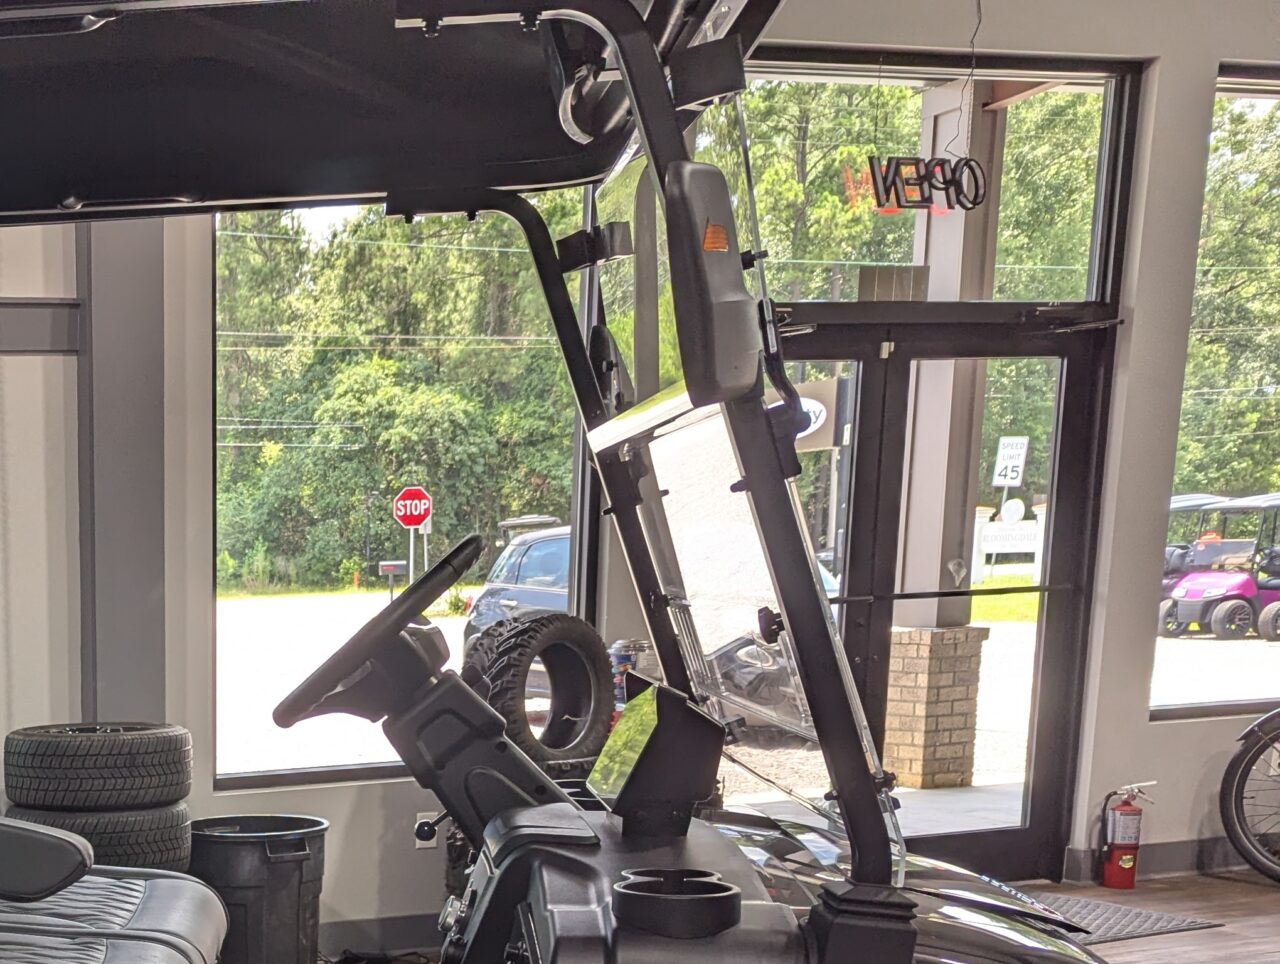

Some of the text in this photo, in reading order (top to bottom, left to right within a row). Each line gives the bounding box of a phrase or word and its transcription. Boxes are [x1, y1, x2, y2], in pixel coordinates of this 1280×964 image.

[1001, 442, 1025, 450] SPEED
[1002, 453, 1021, 461] LIMIT
[998, 465, 1020, 480] 45
[396, 499, 430, 516] STOP
